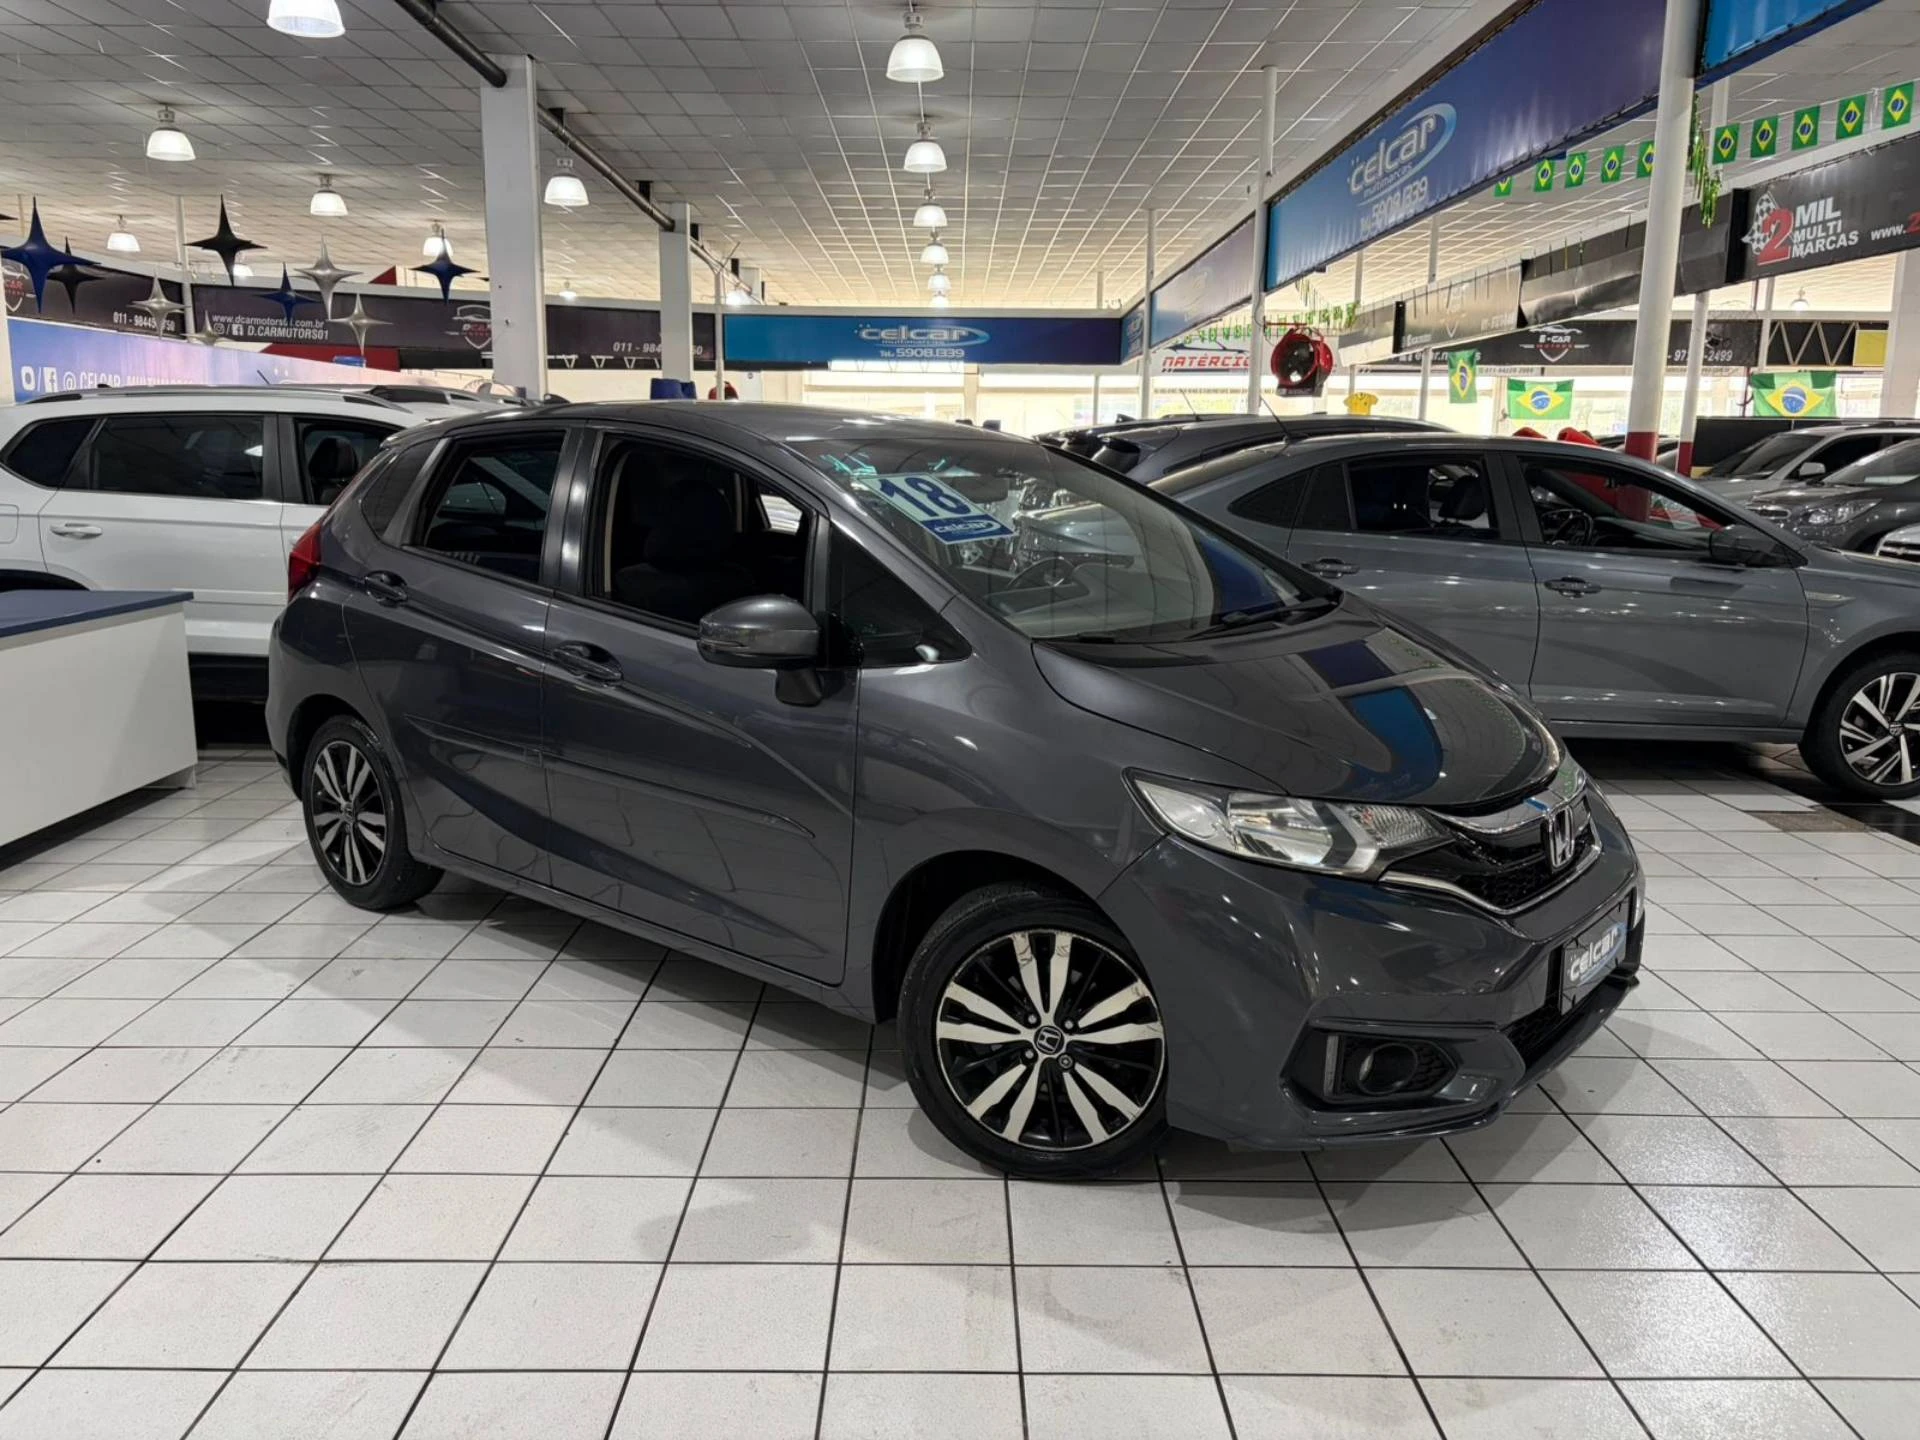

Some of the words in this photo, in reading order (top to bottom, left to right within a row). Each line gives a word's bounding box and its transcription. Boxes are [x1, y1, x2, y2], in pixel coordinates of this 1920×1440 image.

[1350, 114, 1437, 194] celcar
[1757, 208, 1794, 266] 2
[1795, 197, 1842, 228] MIL
[1792, 230, 1860, 259] MARCAS
[1793, 219, 1843, 244] MULTI
[861, 325, 969, 341] celcar
[878, 476, 972, 517] 18
[1569, 923, 1620, 983] celcar
